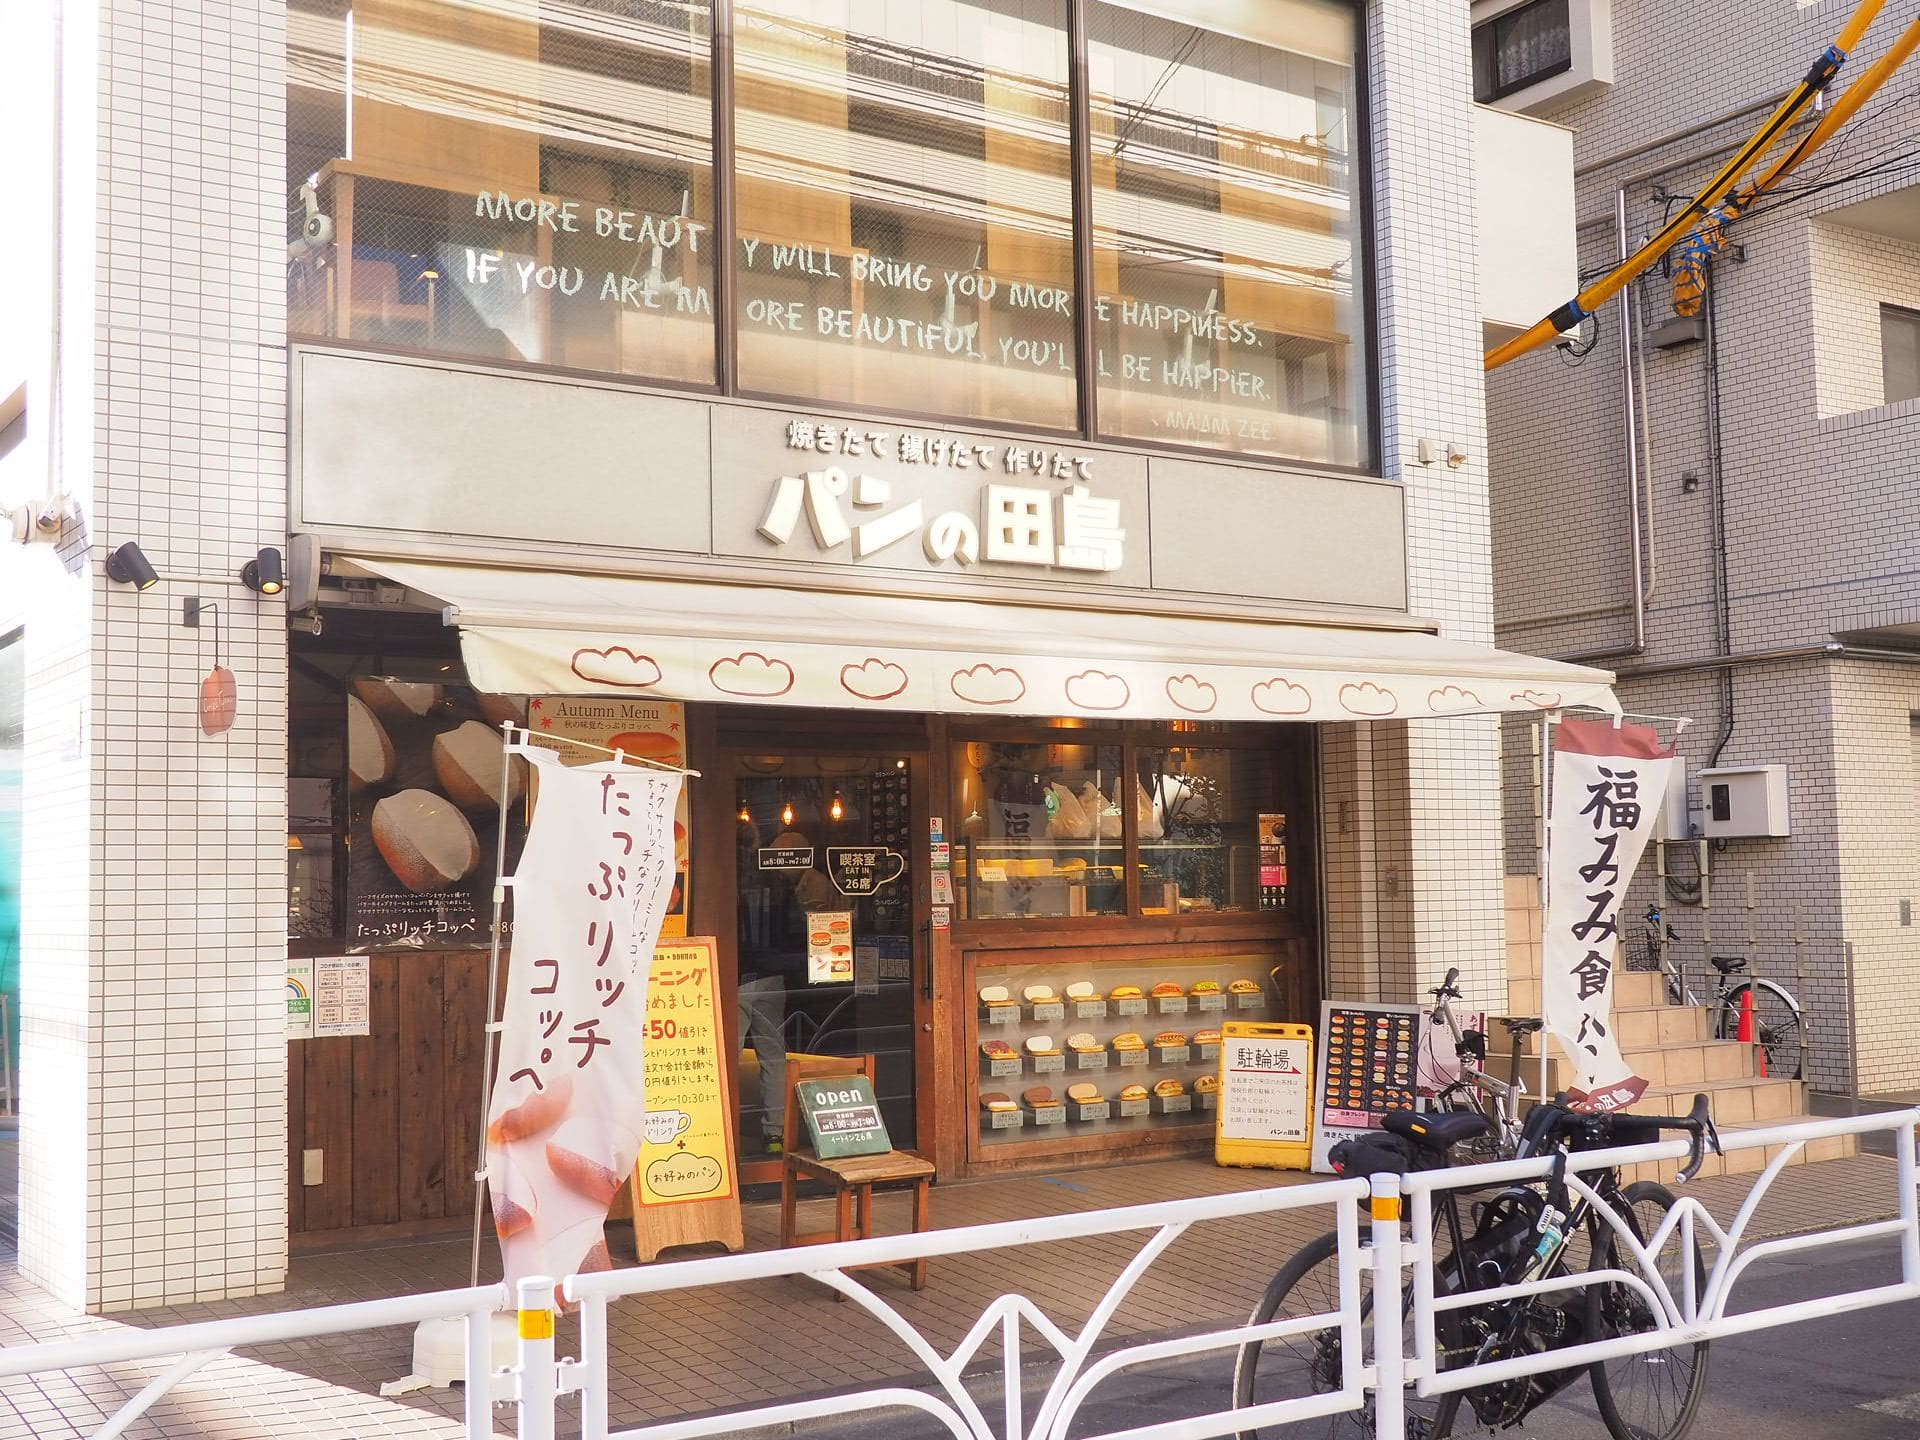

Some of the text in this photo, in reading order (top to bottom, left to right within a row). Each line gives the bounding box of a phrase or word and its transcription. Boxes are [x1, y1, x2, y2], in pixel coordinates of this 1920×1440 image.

[474, 190, 580, 233] MORE
[594, 207, 707, 253] BEAUT
[743, 236, 760, 268] Y
[944, 271, 998, 301] YOU
[1009, 283, 1071, 318] MOR
[1094, 295, 1112, 322] E
[464, 249, 502, 285] IF
[516, 261, 585, 297] YOU
[598, 271, 661, 309] ARE
[745, 299, 805, 331] ORE
[1121, 354, 1153, 382] BE
[786, 419, 1094, 481] 焼きたて 揚げたて 作りたて
[756, 467, 1126, 571] パンの田島
[557, 702, 659, 719] Autumn Menu
[840, 853, 876, 867] 喫茶室
[845, 866, 871, 875] EAT IN
[845, 877, 872, 890] 26席
[357, 918, 476, 937] たっぷリッチコッペ
[509, 958, 564, 1090] コッペ
[1237, 1047, 1291, 1070] 駐輪場
[815, 1088, 864, 1106] open
[653, 1166, 717, 1183] お好みのパン
